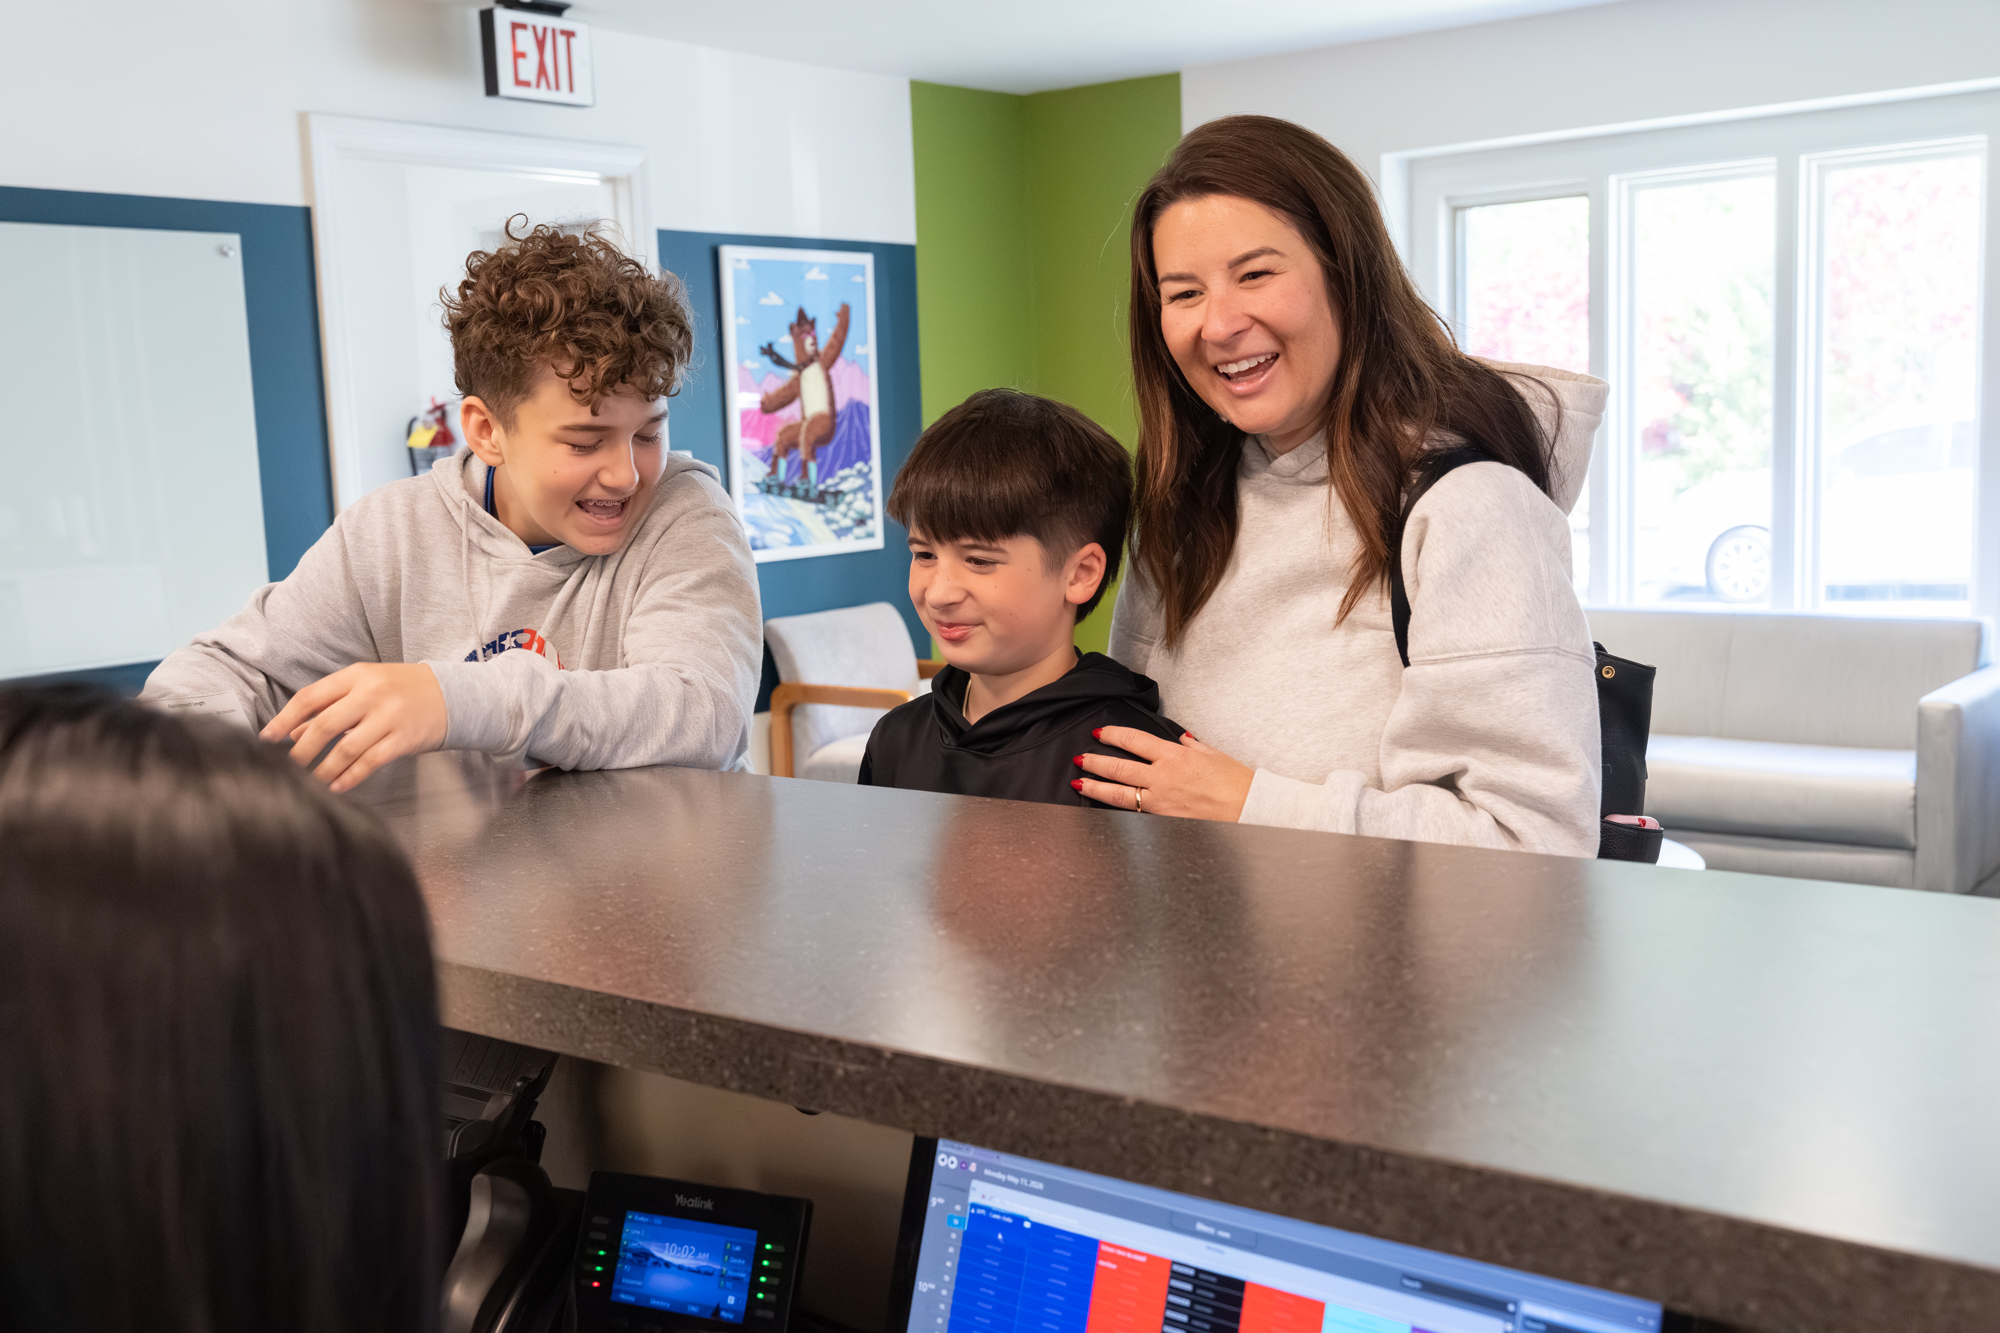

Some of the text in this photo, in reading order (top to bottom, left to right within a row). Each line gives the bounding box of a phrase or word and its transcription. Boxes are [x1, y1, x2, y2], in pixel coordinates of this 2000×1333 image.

[510, 21, 576, 93] EXIT
[675, 1194, 714, 1211] Yealink
[665, 1242, 710, 1260] 10:02 AM
